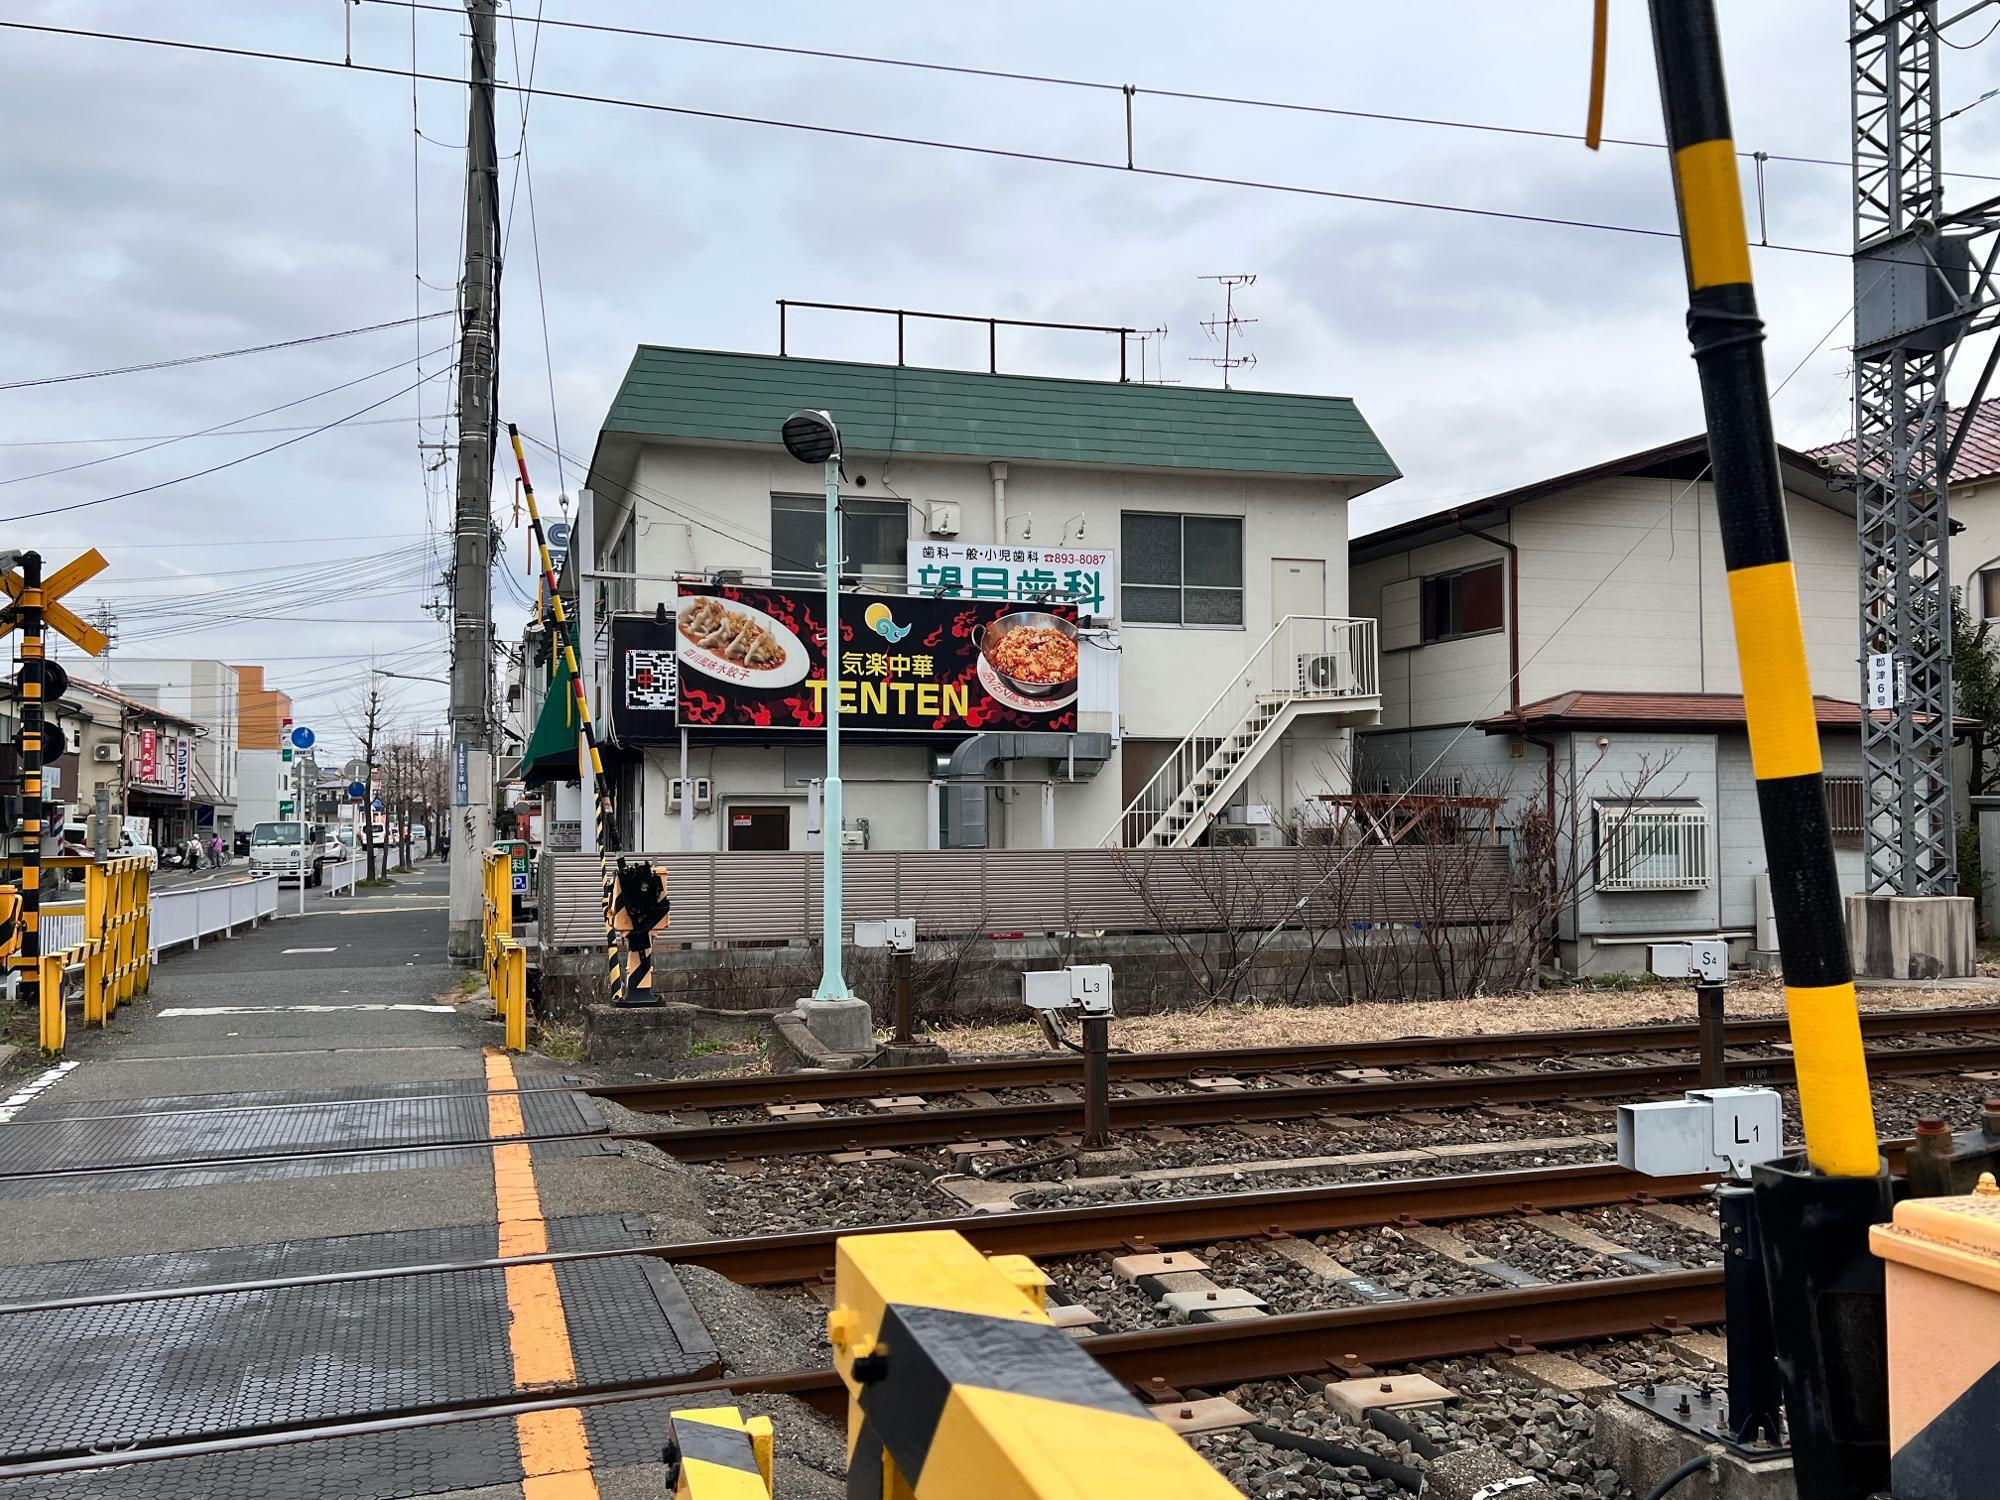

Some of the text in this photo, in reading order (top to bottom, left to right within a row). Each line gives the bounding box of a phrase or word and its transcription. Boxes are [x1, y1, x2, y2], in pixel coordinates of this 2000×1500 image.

[922, 546, 1106, 565] 歯科一般・小児歯科 893-8087
[917, 564, 1105, 614] 望月歯科
[841, 651, 934, 679] 気楽中華
[805, 680, 969, 717] TENTEN
[1702, 951, 1717, 965] S4
[1083, 977, 1100, 993] L3
[1734, 1115, 1759, 1144] L1
